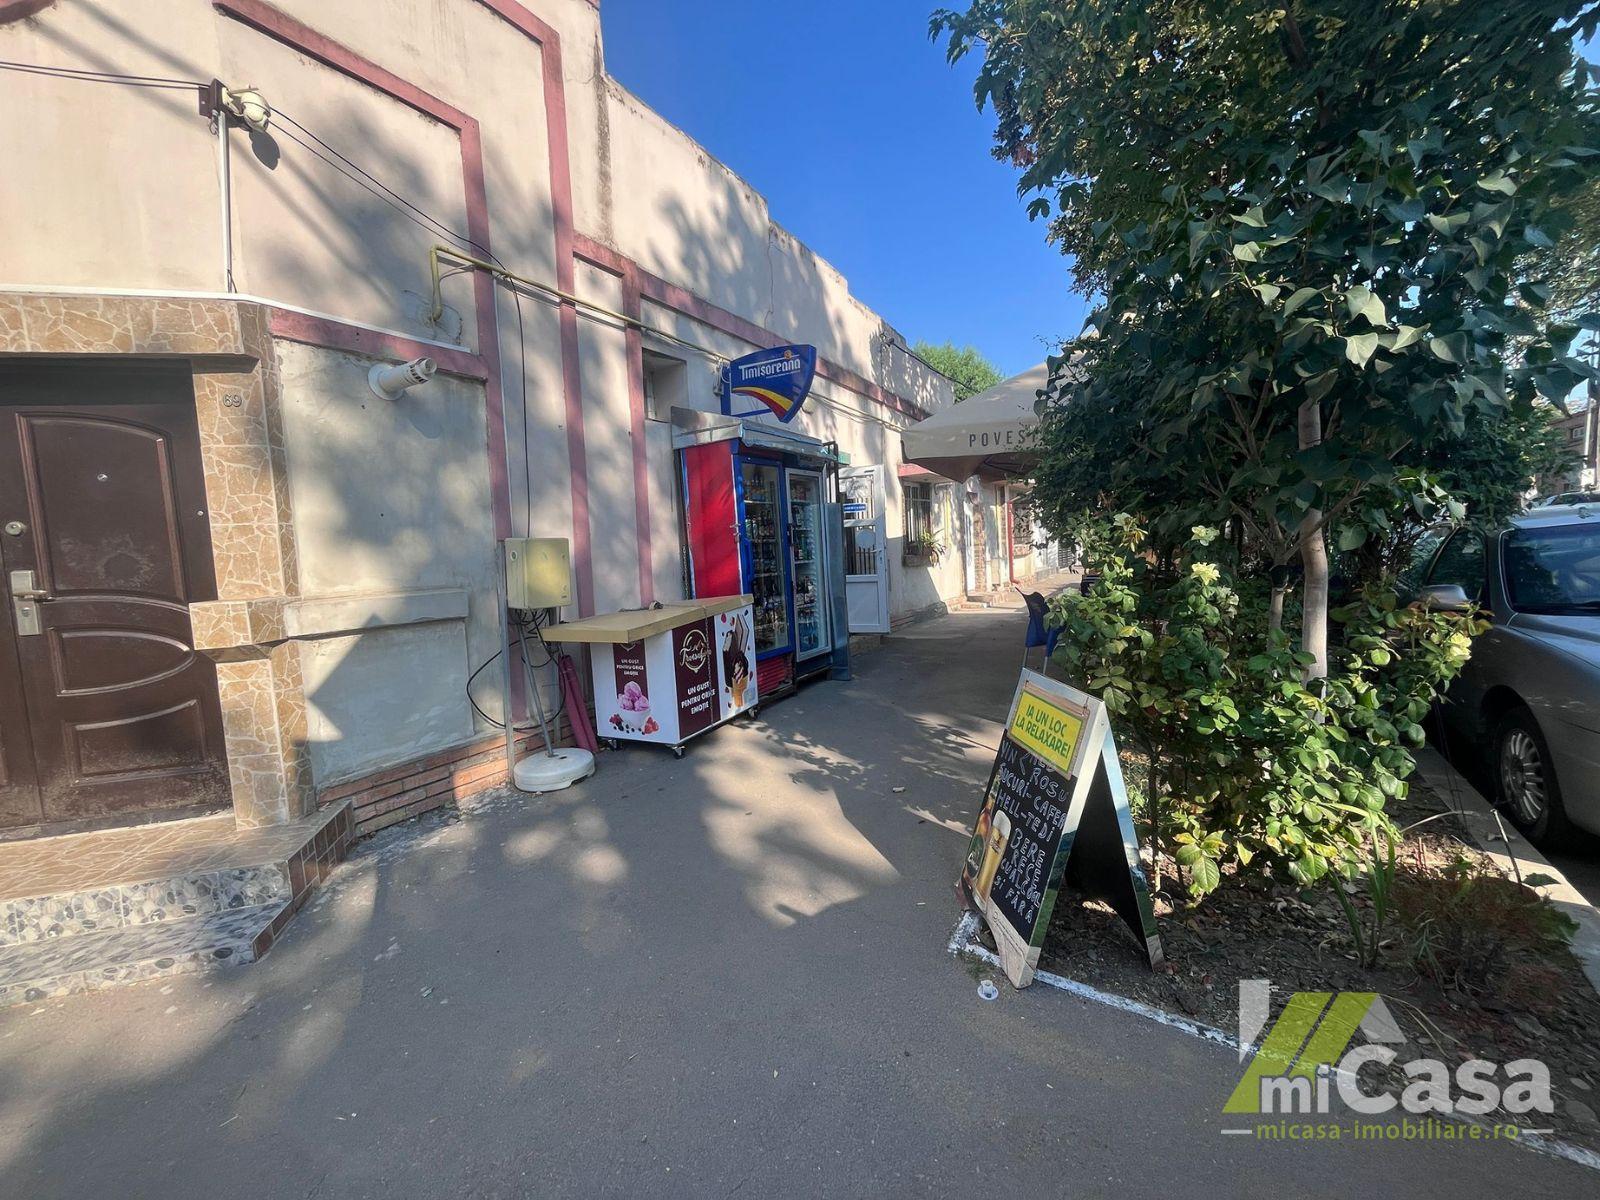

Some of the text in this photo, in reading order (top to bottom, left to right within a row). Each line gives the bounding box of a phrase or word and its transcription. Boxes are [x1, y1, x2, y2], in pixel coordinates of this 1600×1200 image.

[223, 394, 242, 408] 69
[1015, 715, 1071, 759] LA RELAXARE!
[1026, 704, 1068, 738] IA UN LOC
[1010, 827, 1046, 868] BERE
[1010, 848, 1042, 890] RECE
